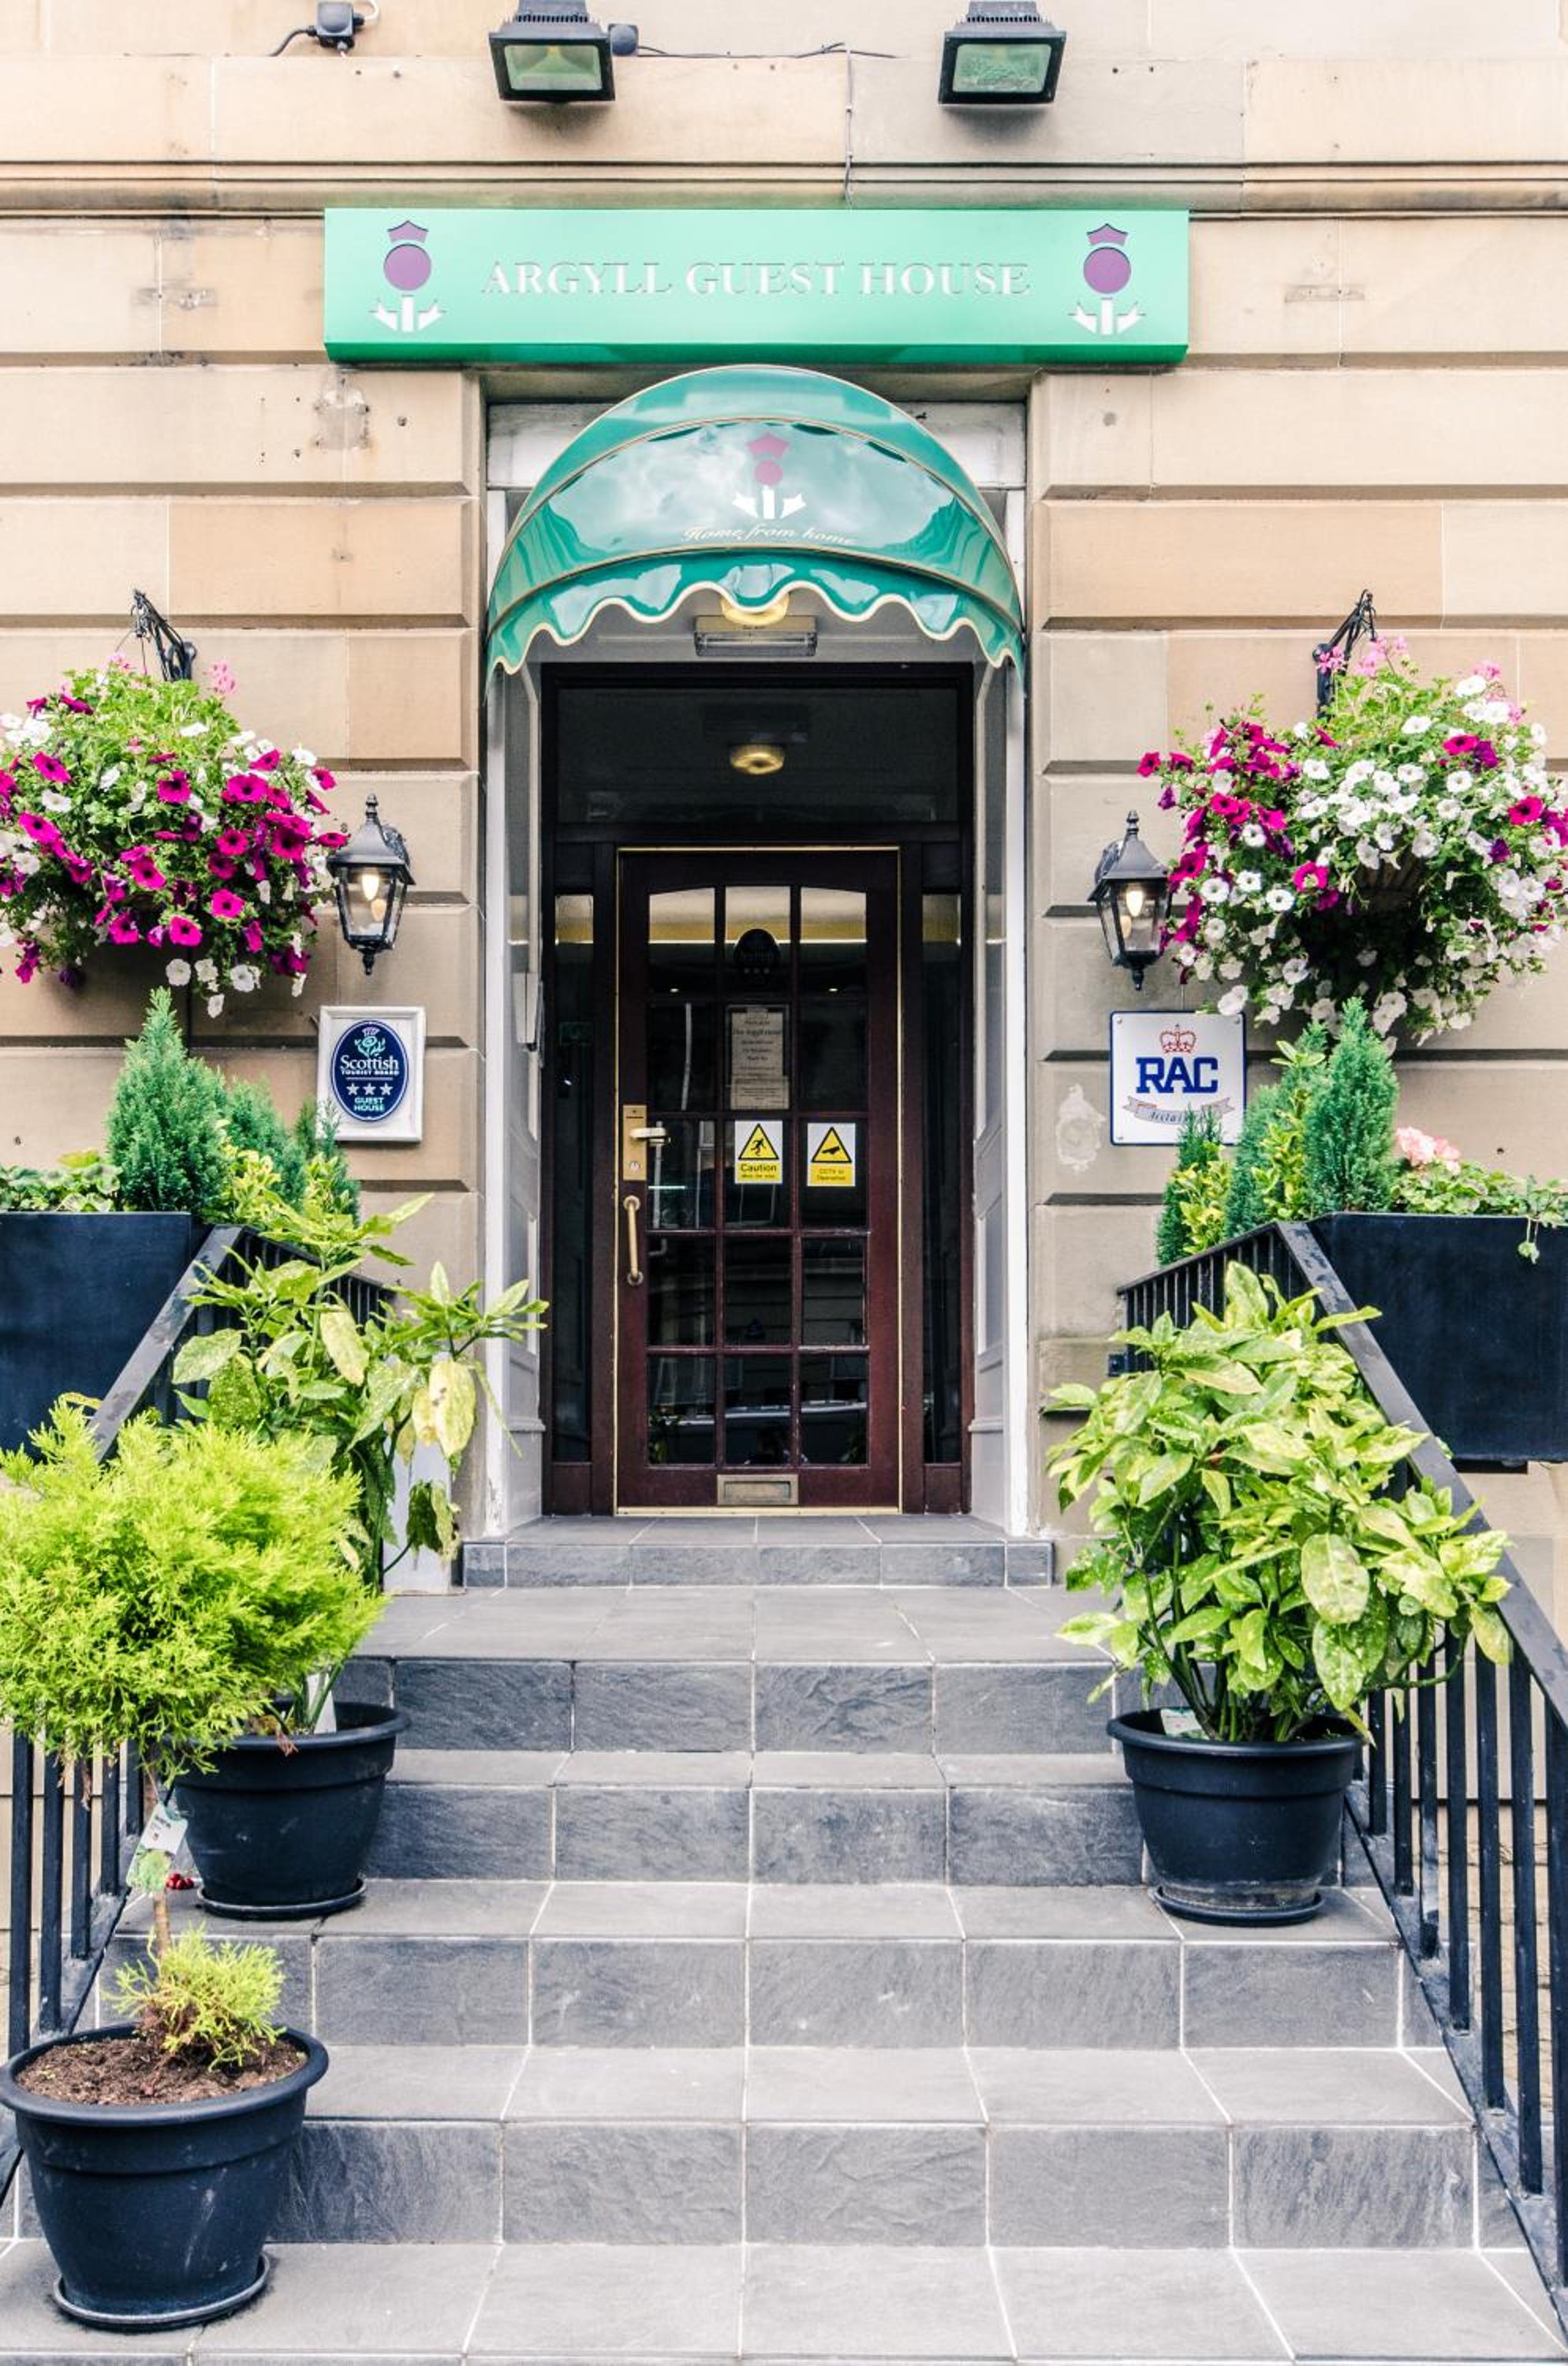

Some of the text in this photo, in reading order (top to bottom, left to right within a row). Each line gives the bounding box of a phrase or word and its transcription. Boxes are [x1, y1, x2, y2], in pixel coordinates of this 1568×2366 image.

[481, 261, 1033, 296] ARGYLL GUEST HOUSE
[745, 524, 796, 541] from
[802, 527, 858, 545] home
[340, 1054, 399, 1070] Scottish
[1135, 1056, 1219, 1094] RAC
[741, 1163, 777, 1172] Caution
